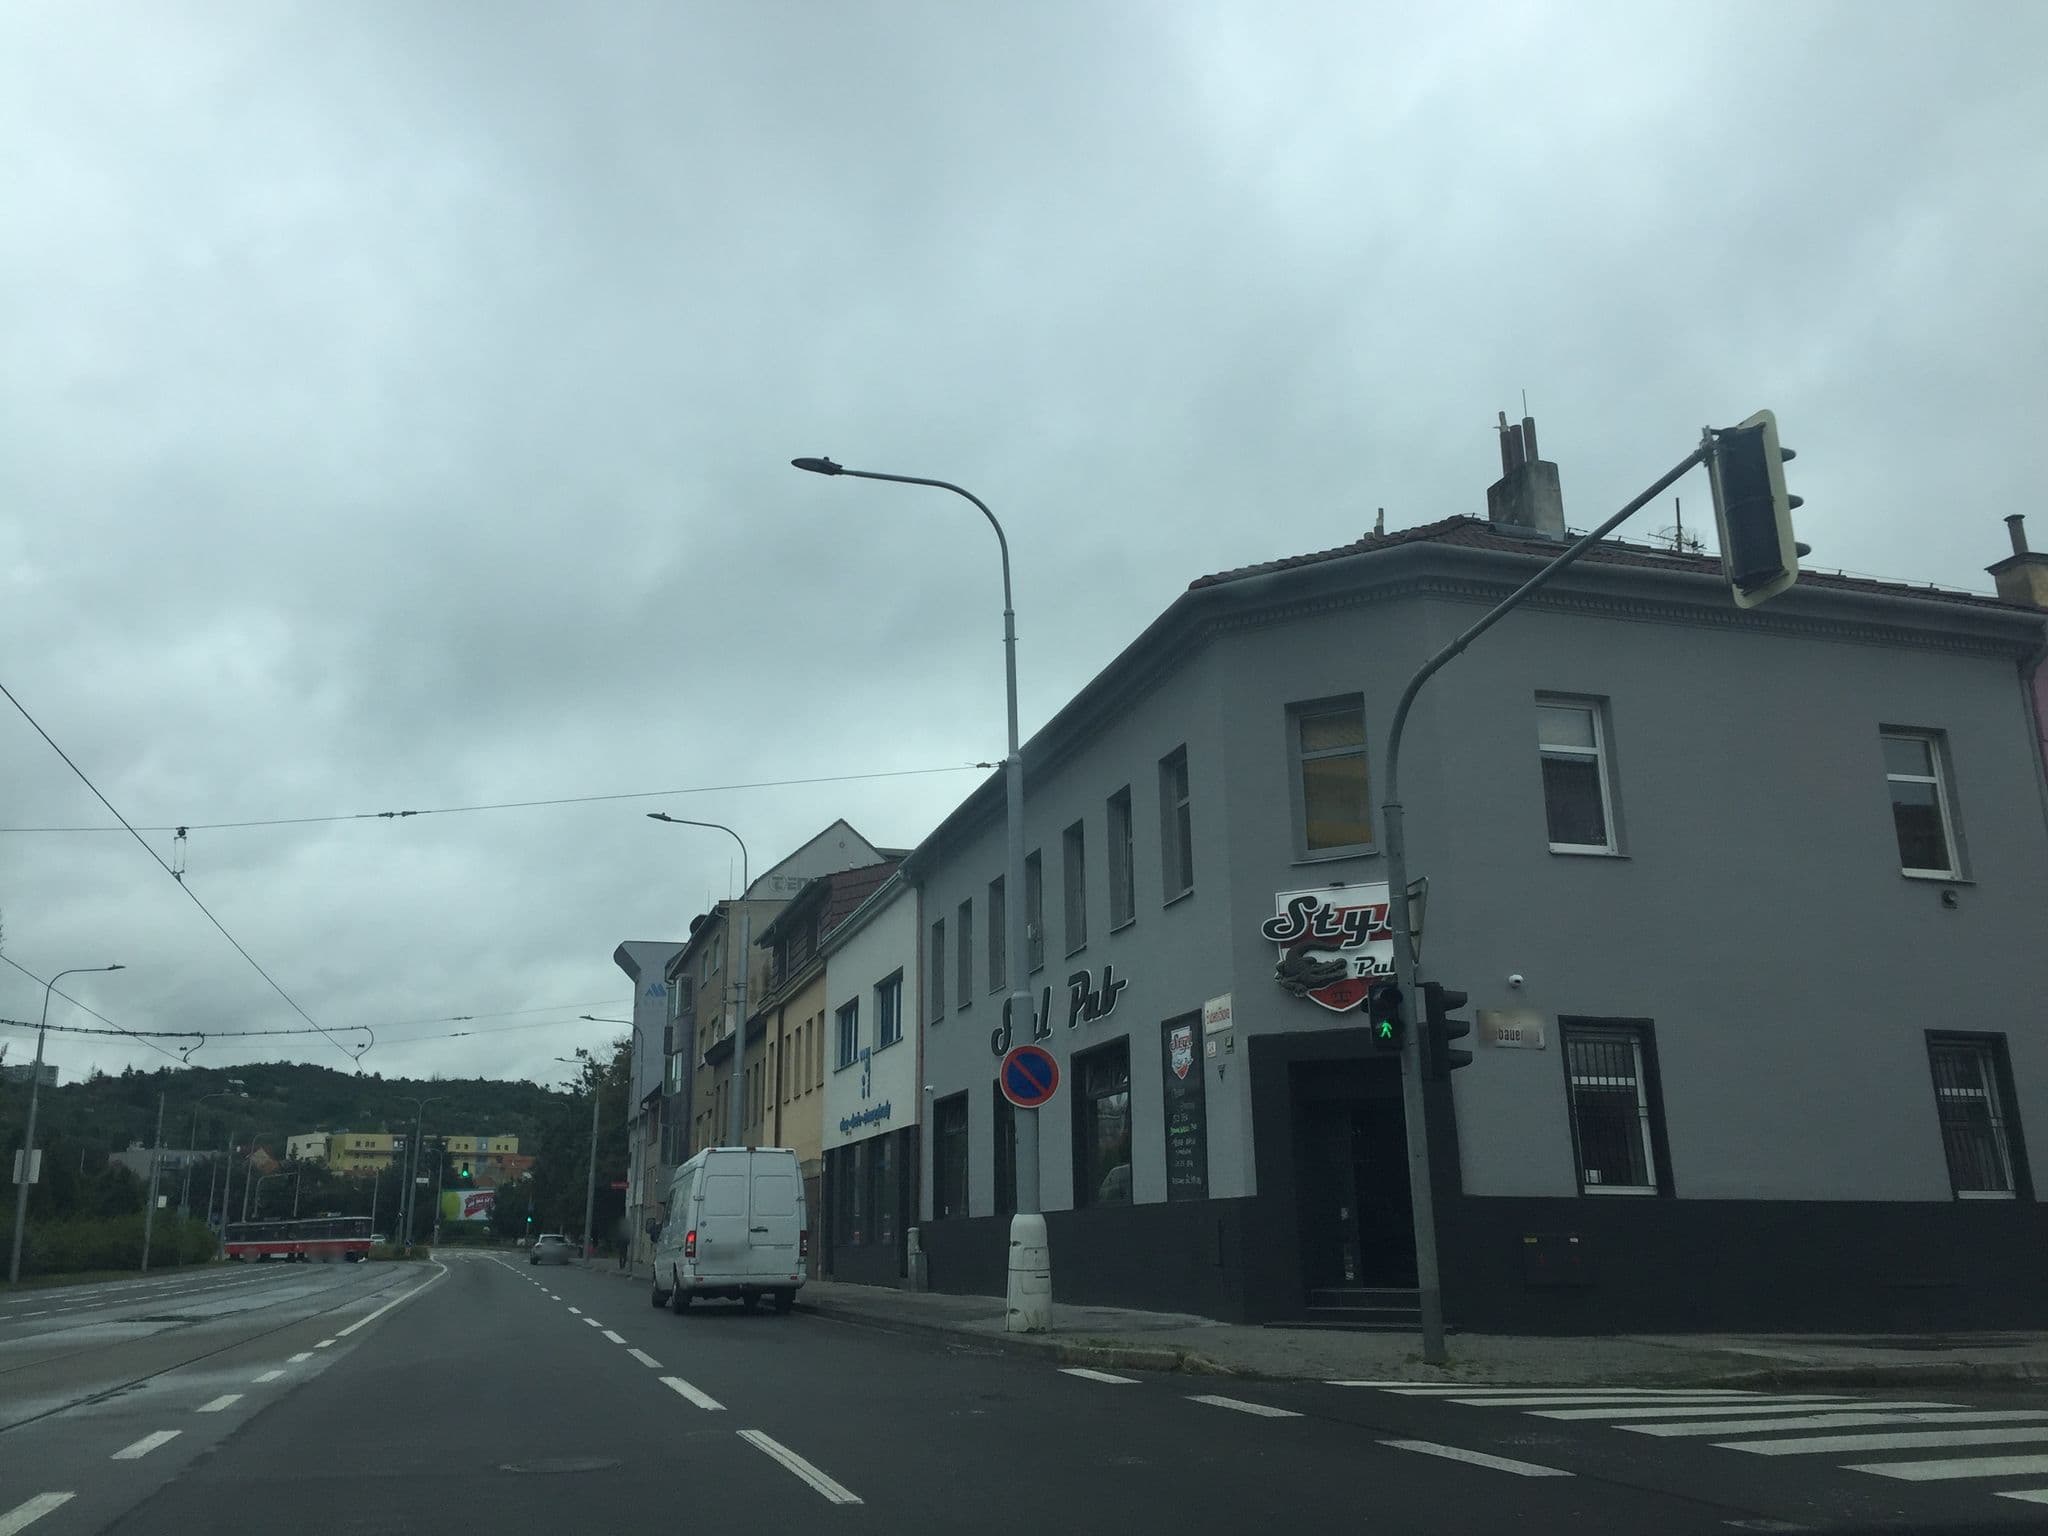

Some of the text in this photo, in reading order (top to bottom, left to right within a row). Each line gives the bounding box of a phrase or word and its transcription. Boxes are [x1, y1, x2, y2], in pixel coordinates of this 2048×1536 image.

[1261, 895, 1393, 949] Sty
[991, 964, 1129, 1057] Sl Pub
